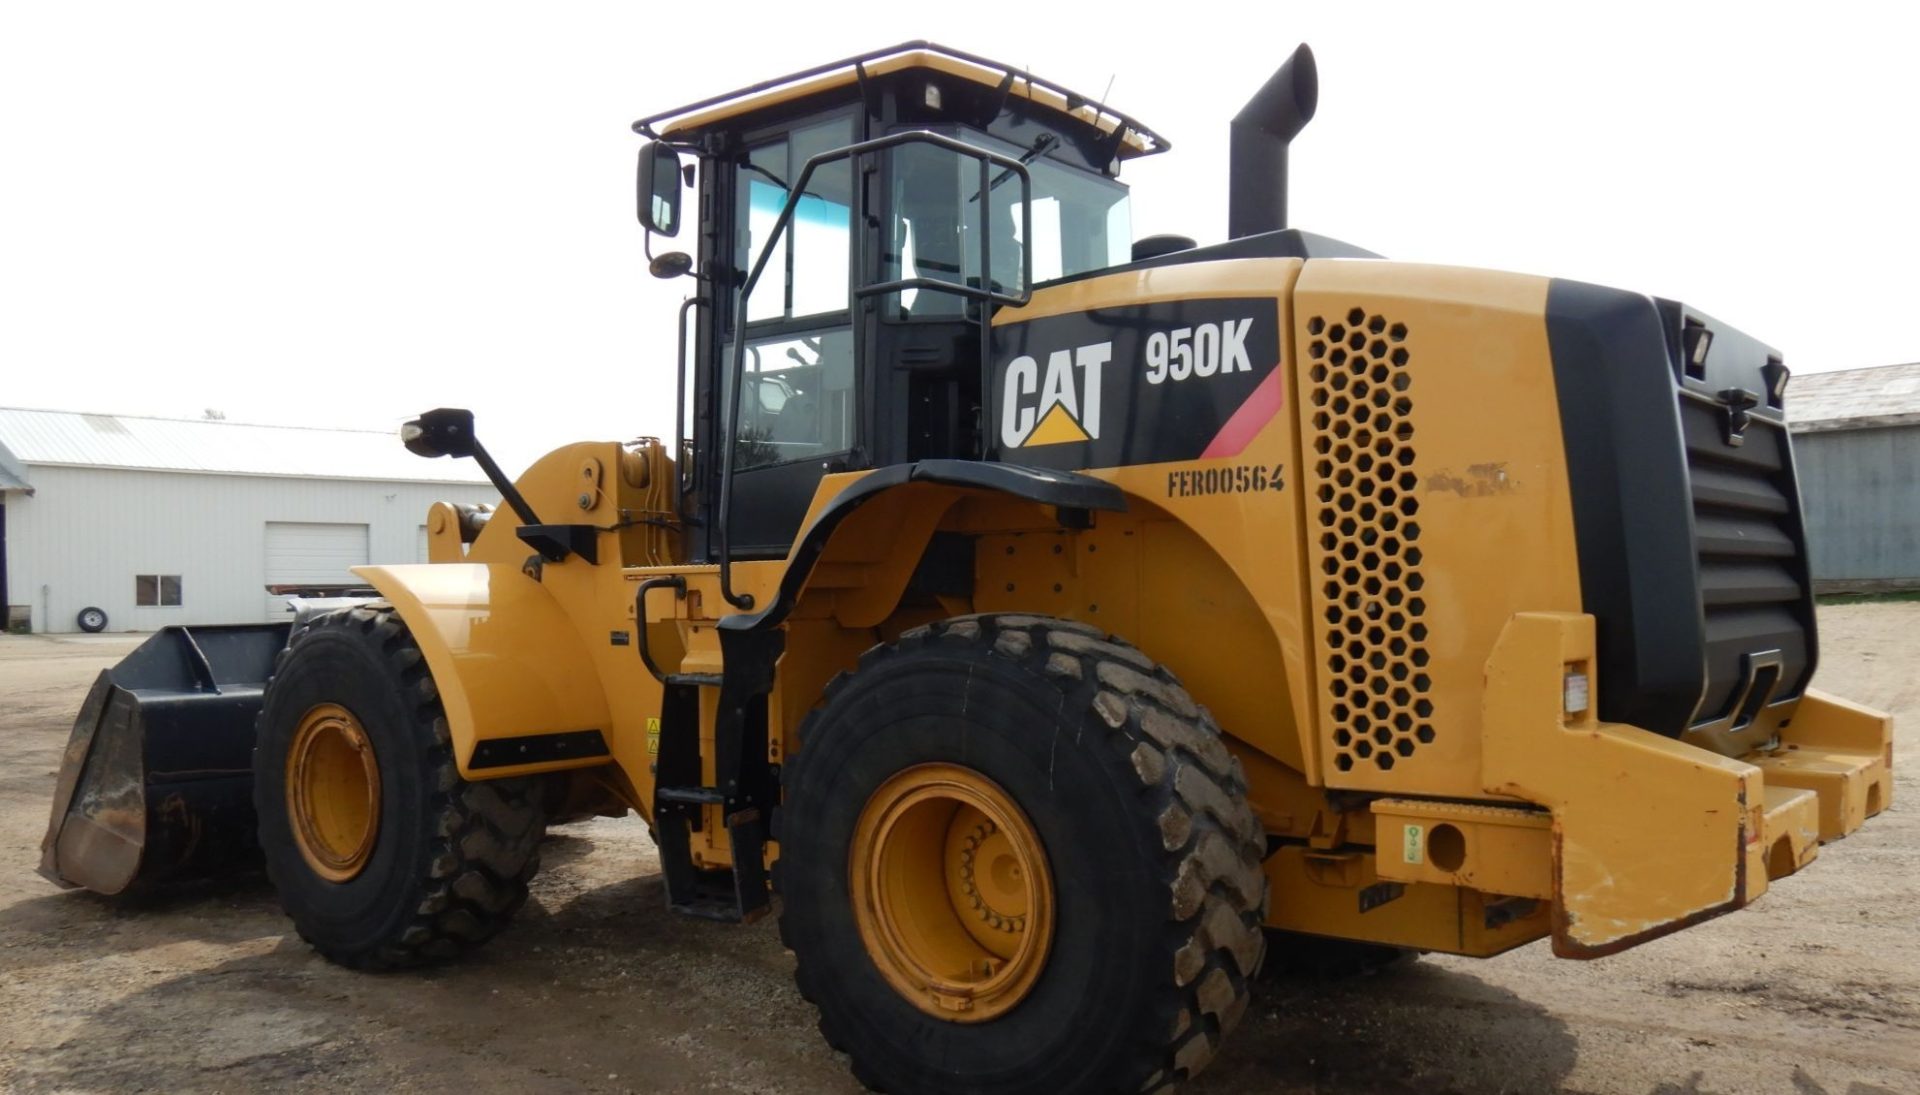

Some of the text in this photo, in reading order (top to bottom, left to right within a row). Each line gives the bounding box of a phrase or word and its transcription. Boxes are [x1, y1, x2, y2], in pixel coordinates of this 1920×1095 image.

[1146, 318, 1253, 384] 950K
[1002, 342, 1111, 448] CAT
[1168, 464, 1285, 497] FER00564
